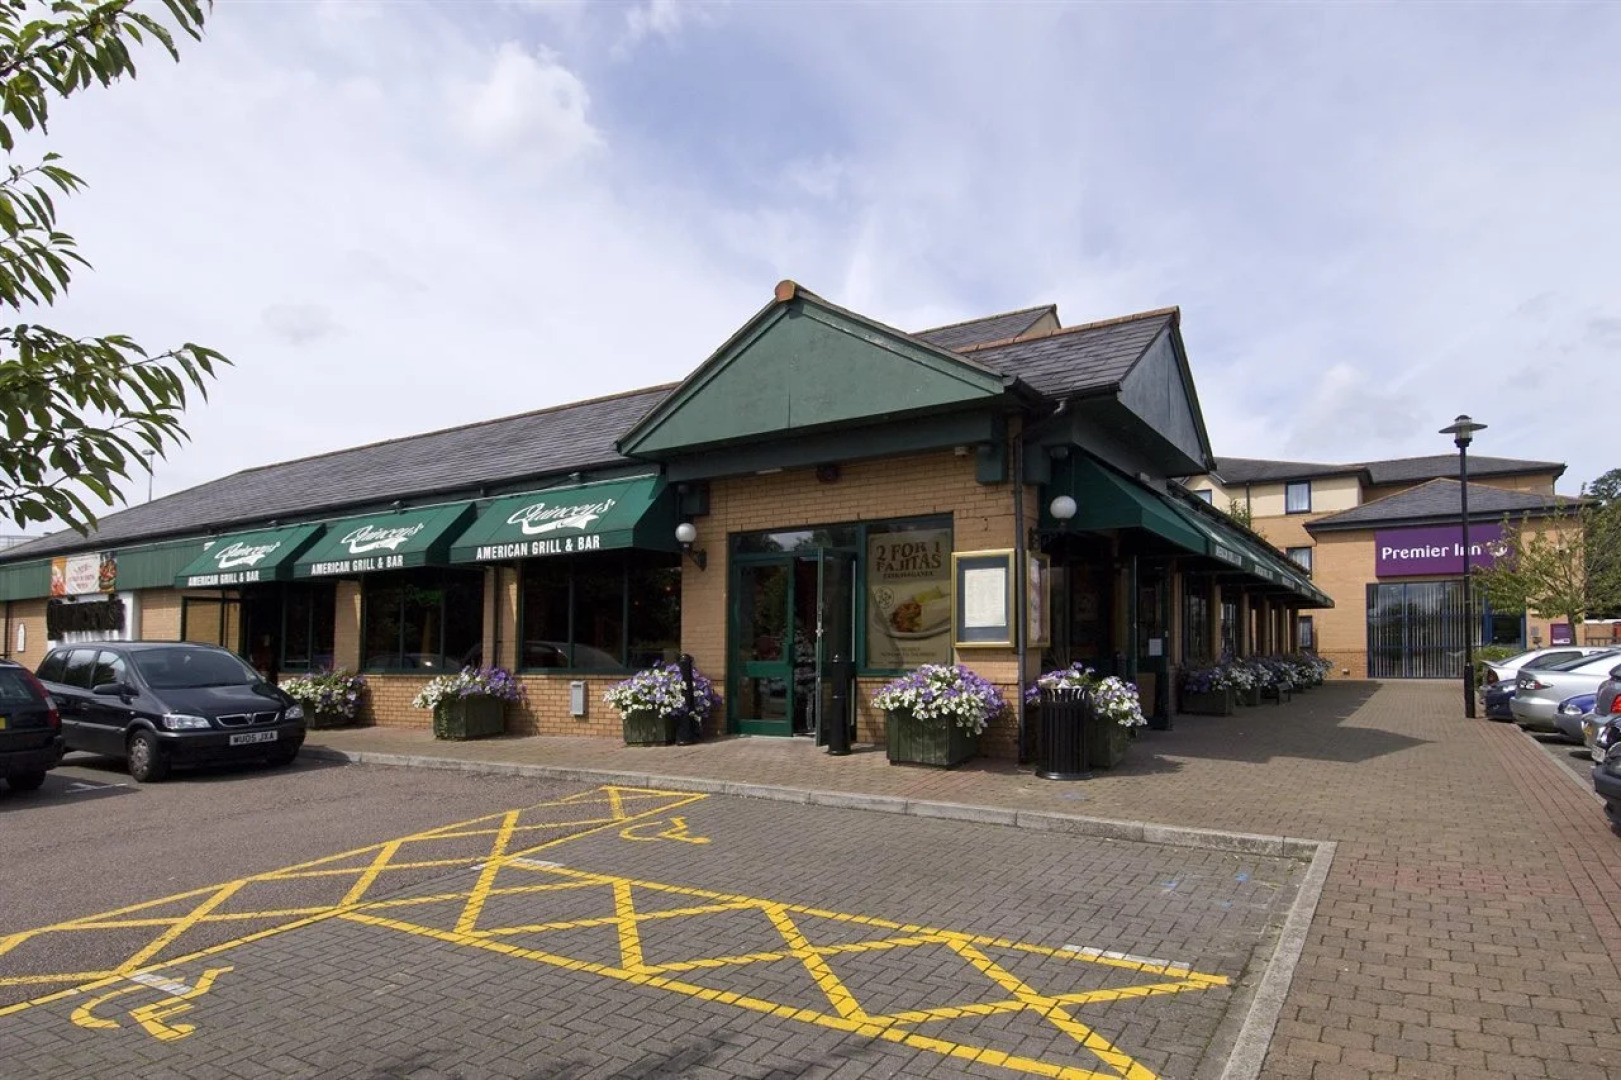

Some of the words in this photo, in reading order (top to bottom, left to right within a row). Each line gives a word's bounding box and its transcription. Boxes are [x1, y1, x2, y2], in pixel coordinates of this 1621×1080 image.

[476, 545, 528, 560] AMERICAN
[532, 539, 562, 555] GRILL
[565, 538, 573, 552] &
[578, 535, 600, 551] BAR
[876, 545, 886, 561] 2
[891, 541, 927, 561] FOR
[935, 541, 940, 553] 1
[1382, 545, 1449, 560] Premier
[311, 561, 351, 576] AMERICAN
[352, 558, 375, 575] GRILL
[377, 557, 383, 569] &
[386, 555, 404, 568] BAR
[876, 553, 941, 572] FAJITAS
[188, 575, 219, 587] AMERICAN
[220, 572, 237, 585] GRILL
[239, 571, 244, 583] &
[246, 570, 259, 582] BAR
